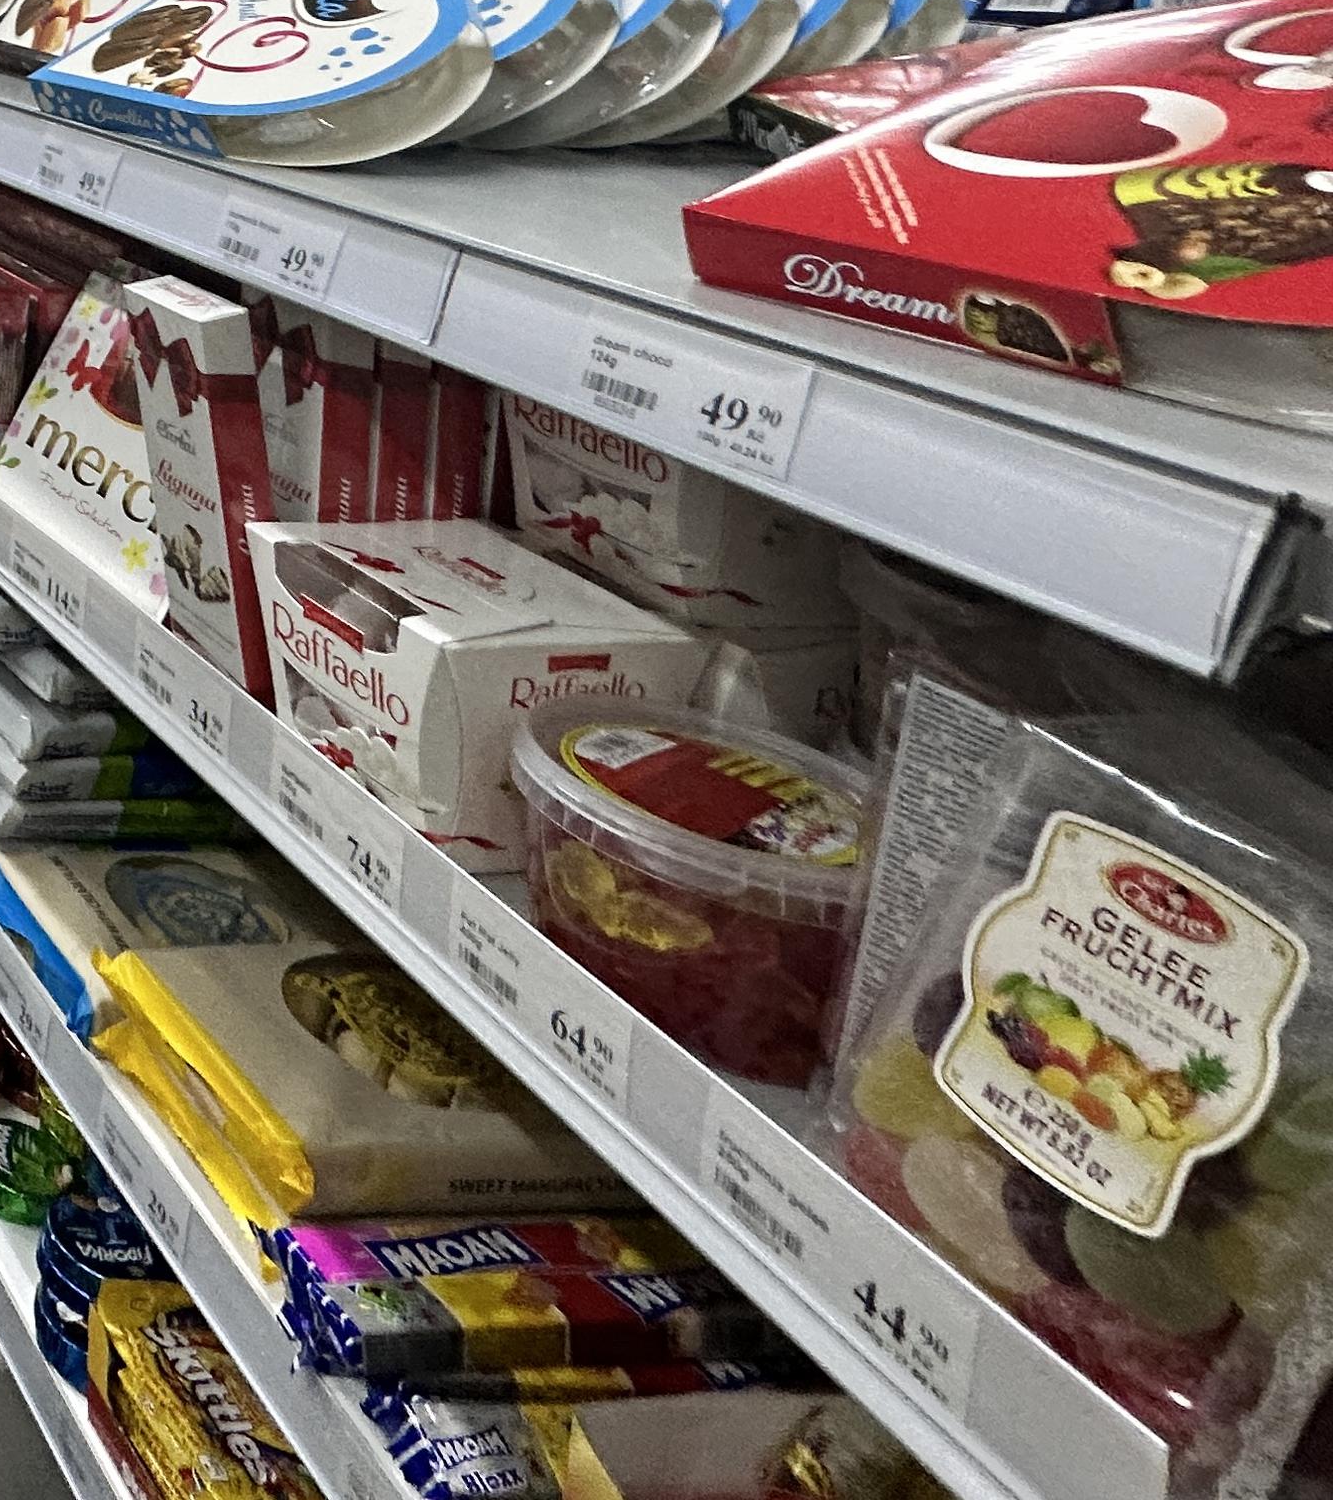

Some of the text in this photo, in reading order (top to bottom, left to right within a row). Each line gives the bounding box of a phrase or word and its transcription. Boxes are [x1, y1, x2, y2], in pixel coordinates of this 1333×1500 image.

[78, 171, 97, 192] 49
[280, 245, 308, 273] 49
[783, 253, 957, 324] Dream
[590, 348, 618, 369] 124g
[700, 392, 749, 431] 49
[758, 404, 782, 428] 90
[513, 395, 671, 485] Raffaello
[25, 413, 156, 524] merc
[46, 577, 69, 611] 114
[270, 600, 410, 727] Raffaello
[188, 698, 208, 732] 34
[346, 833, 372, 876] 74
[1040, 905, 1243, 1040] FRUCHTMIX
[1091, 905, 1212, 991] GELEE
[550, 1008, 587, 1056] 64
[593, 1036, 614, 1066] 90
[76, 1240, 155, 1266] FIDORKA
[381, 1225, 533, 1280] MAOAM
[853, 1280, 907, 1343] 44
[148, 1317, 271, 1486] Skittles
[437, 1430, 510, 1468] MAOAM
[462, 1467, 524, 1495] Bloxx
